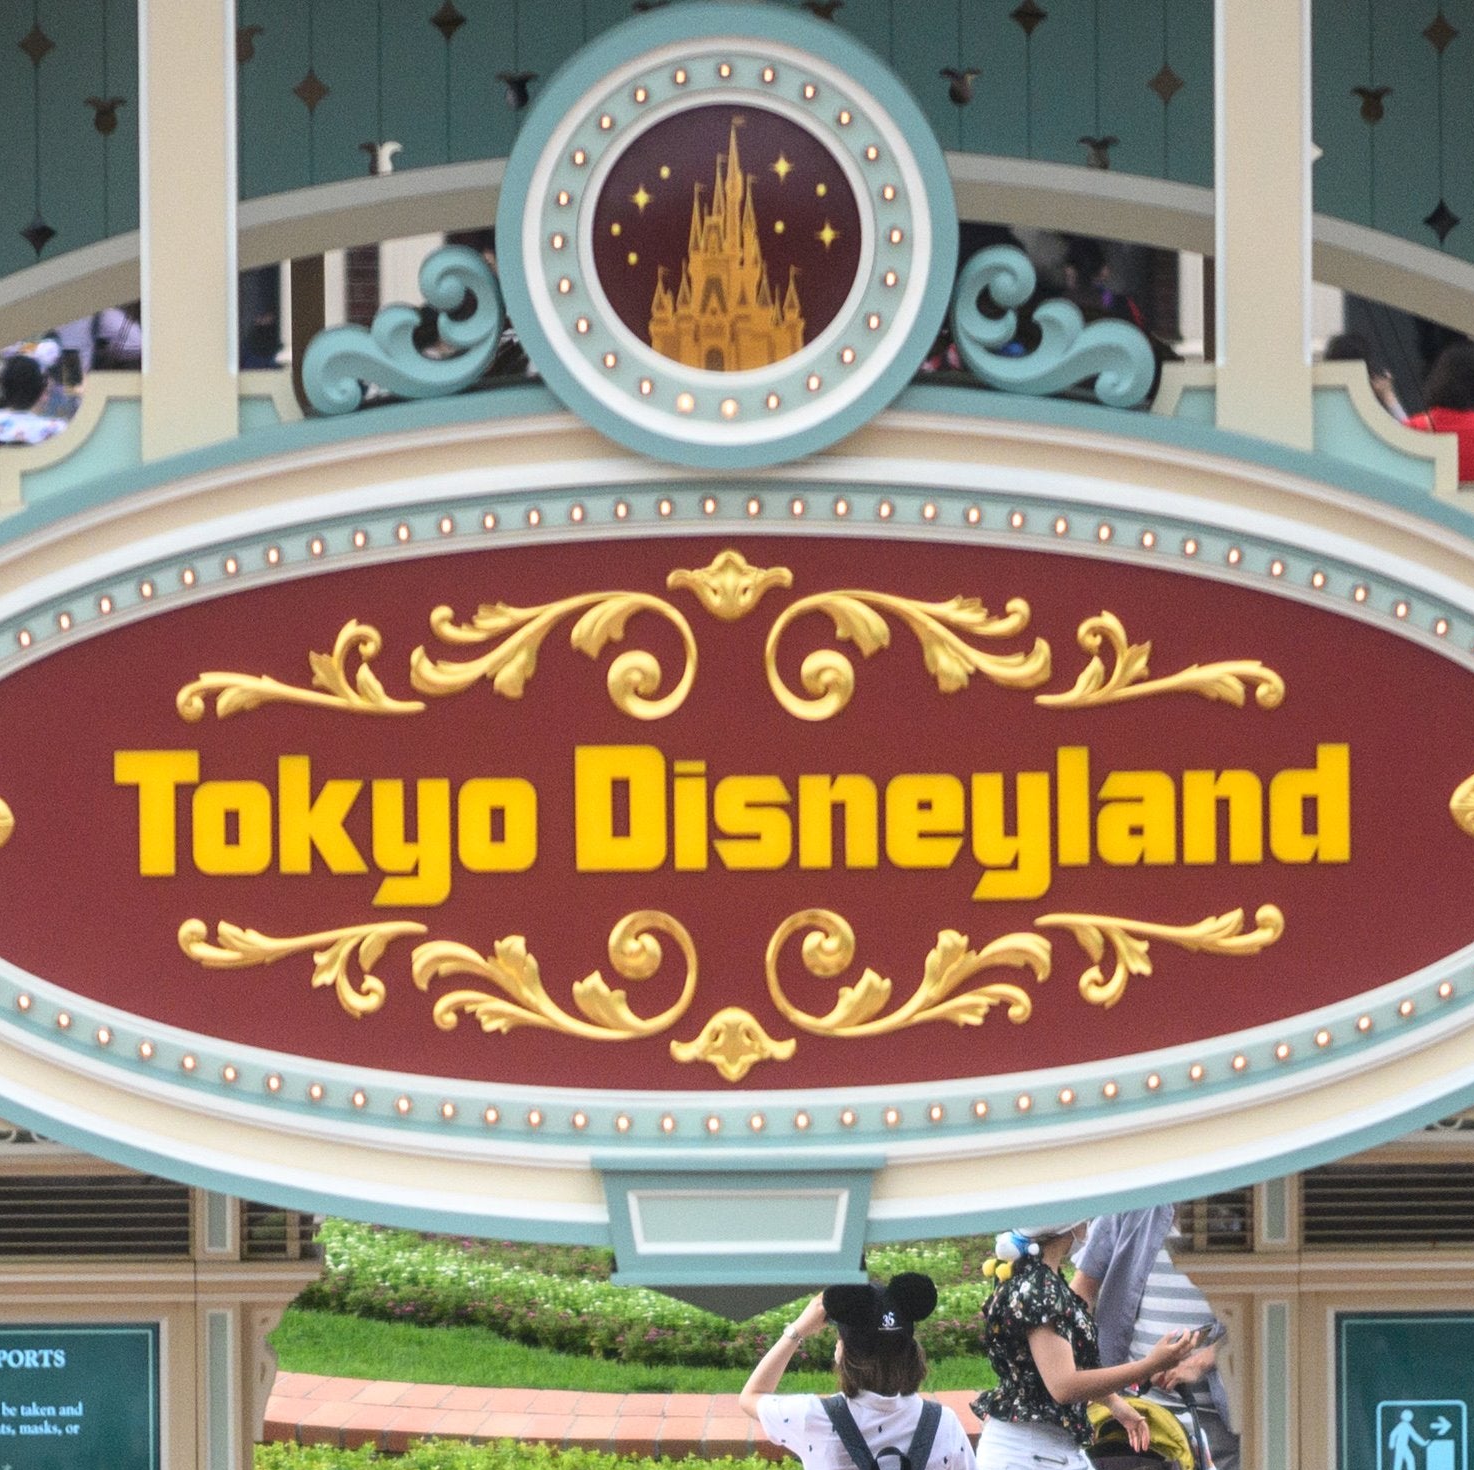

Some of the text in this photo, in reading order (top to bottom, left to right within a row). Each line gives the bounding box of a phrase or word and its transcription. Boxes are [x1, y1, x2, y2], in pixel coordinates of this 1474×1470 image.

[114, 743, 1352, 907] Tokyo Disneyland
[0, 1401, 17, 1417] be
[20, 1401, 56, 1417] taken
[58, 1400, 83, 1417] and
[18, 1420, 62, 1437] masks,
[65, 1423, 80, 1435] or
